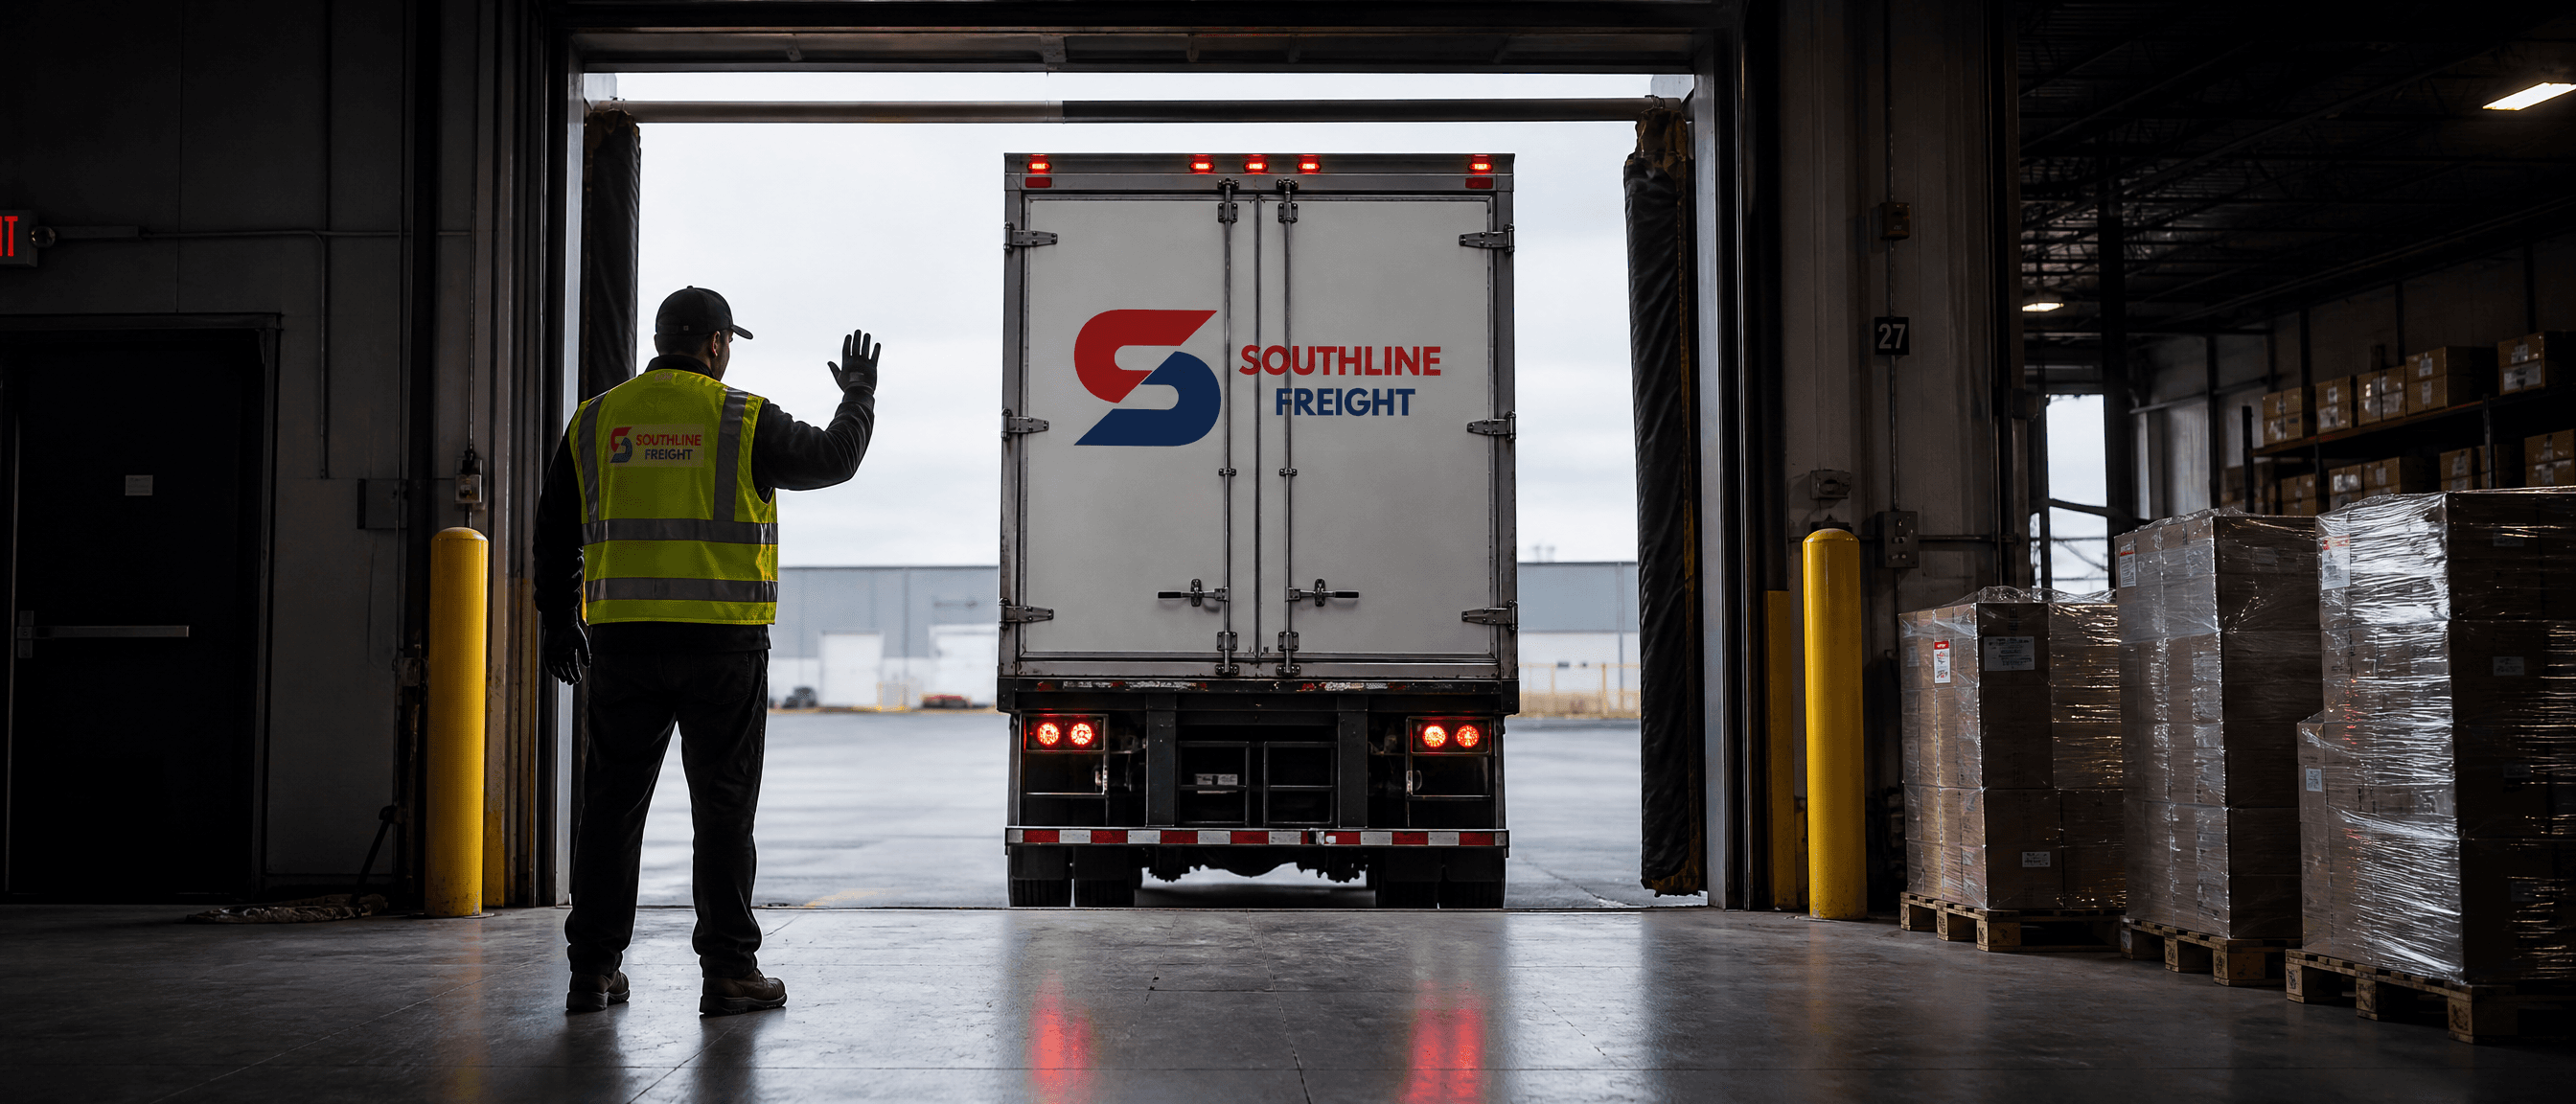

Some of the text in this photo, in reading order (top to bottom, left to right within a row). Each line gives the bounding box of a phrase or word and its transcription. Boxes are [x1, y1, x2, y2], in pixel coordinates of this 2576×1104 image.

[1878, 323, 1906, 350] 27
[1239, 345, 1440, 376] SOUTHLINE
[1276, 388, 1415, 416] FREIGHT
[636, 434, 702, 447] SOUTHLINE
[645, 448, 693, 460] FREIGHT
